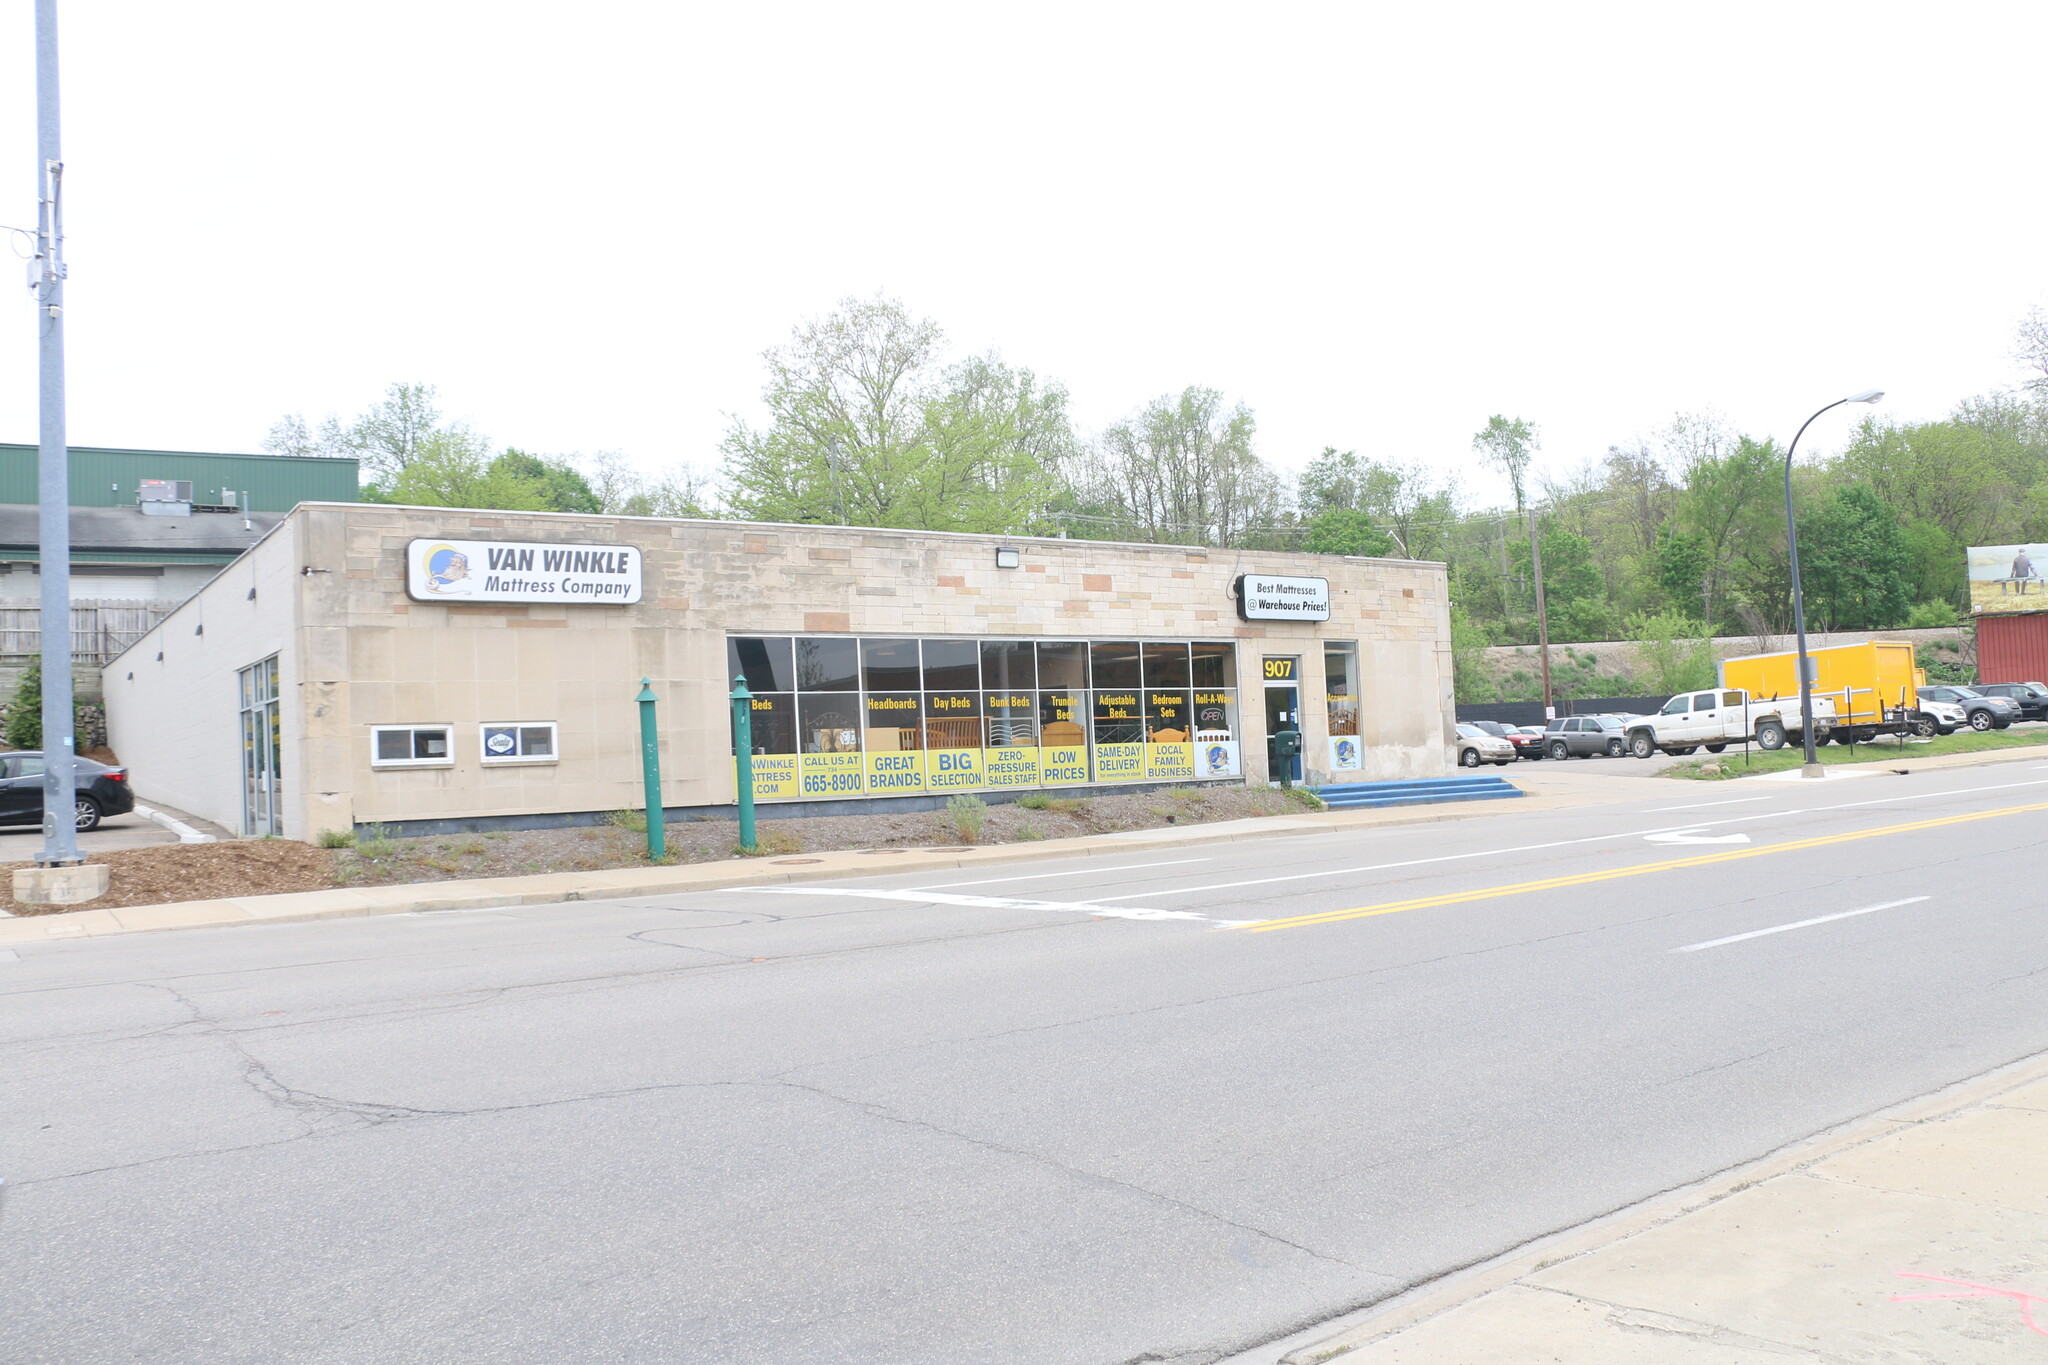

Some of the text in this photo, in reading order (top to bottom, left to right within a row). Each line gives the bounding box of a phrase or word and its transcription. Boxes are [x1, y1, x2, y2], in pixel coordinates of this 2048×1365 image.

[488, 548, 629, 574] VAN WINKLE
[484, 575, 631, 598] Mattress Company
[1257, 582, 1317, 596] Best Mattresses
[1247, 599, 1327, 612] @ Warehouse Prices!
[1265, 660, 1292, 677] 907
[751, 699, 773, 710] Beds
[867, 697, 917, 710] Headboards
[933, 696, 971, 711] Day Beds
[990, 695, 1030, 708] Bunk Beds
[1051, 695, 1078, 707] Trundle
[1099, 694, 1136, 707] Adjustable
[1152, 694, 1182, 706] Bedroom
[1056, 709, 1075, 721] Beds
[1109, 707, 1127, 718] Beds
[1160, 707, 1175, 718] Sets
[1201, 711, 1224, 721] OPEN
[490, 737, 511, 749] Sealy
[998, 751, 1026, 761] ZERO-
[1097, 746, 1141, 759] SAME-DAY
[1156, 745, 1183, 756] LOCAL
[804, 756, 859, 767] CALL US AT
[874, 756, 915, 771] GREAT
[938, 753, 973, 771] BIG
[1052, 751, 1077, 764] LOW
[1154, 756, 1185, 767] FAMILY
[988, 762, 1037, 773] PRESSURE
[1099, 758, 1140, 772] DELIVERY
[1044, 767, 1085, 781] PRICES
[1148, 767, 1192, 777] BUSINESS
[804, 773, 861, 792] 665-8900
[870, 772, 921, 788] BRANDS
[931, 772, 982, 786] SELECTION
[988, 773, 1037, 786] SALES STAFF
